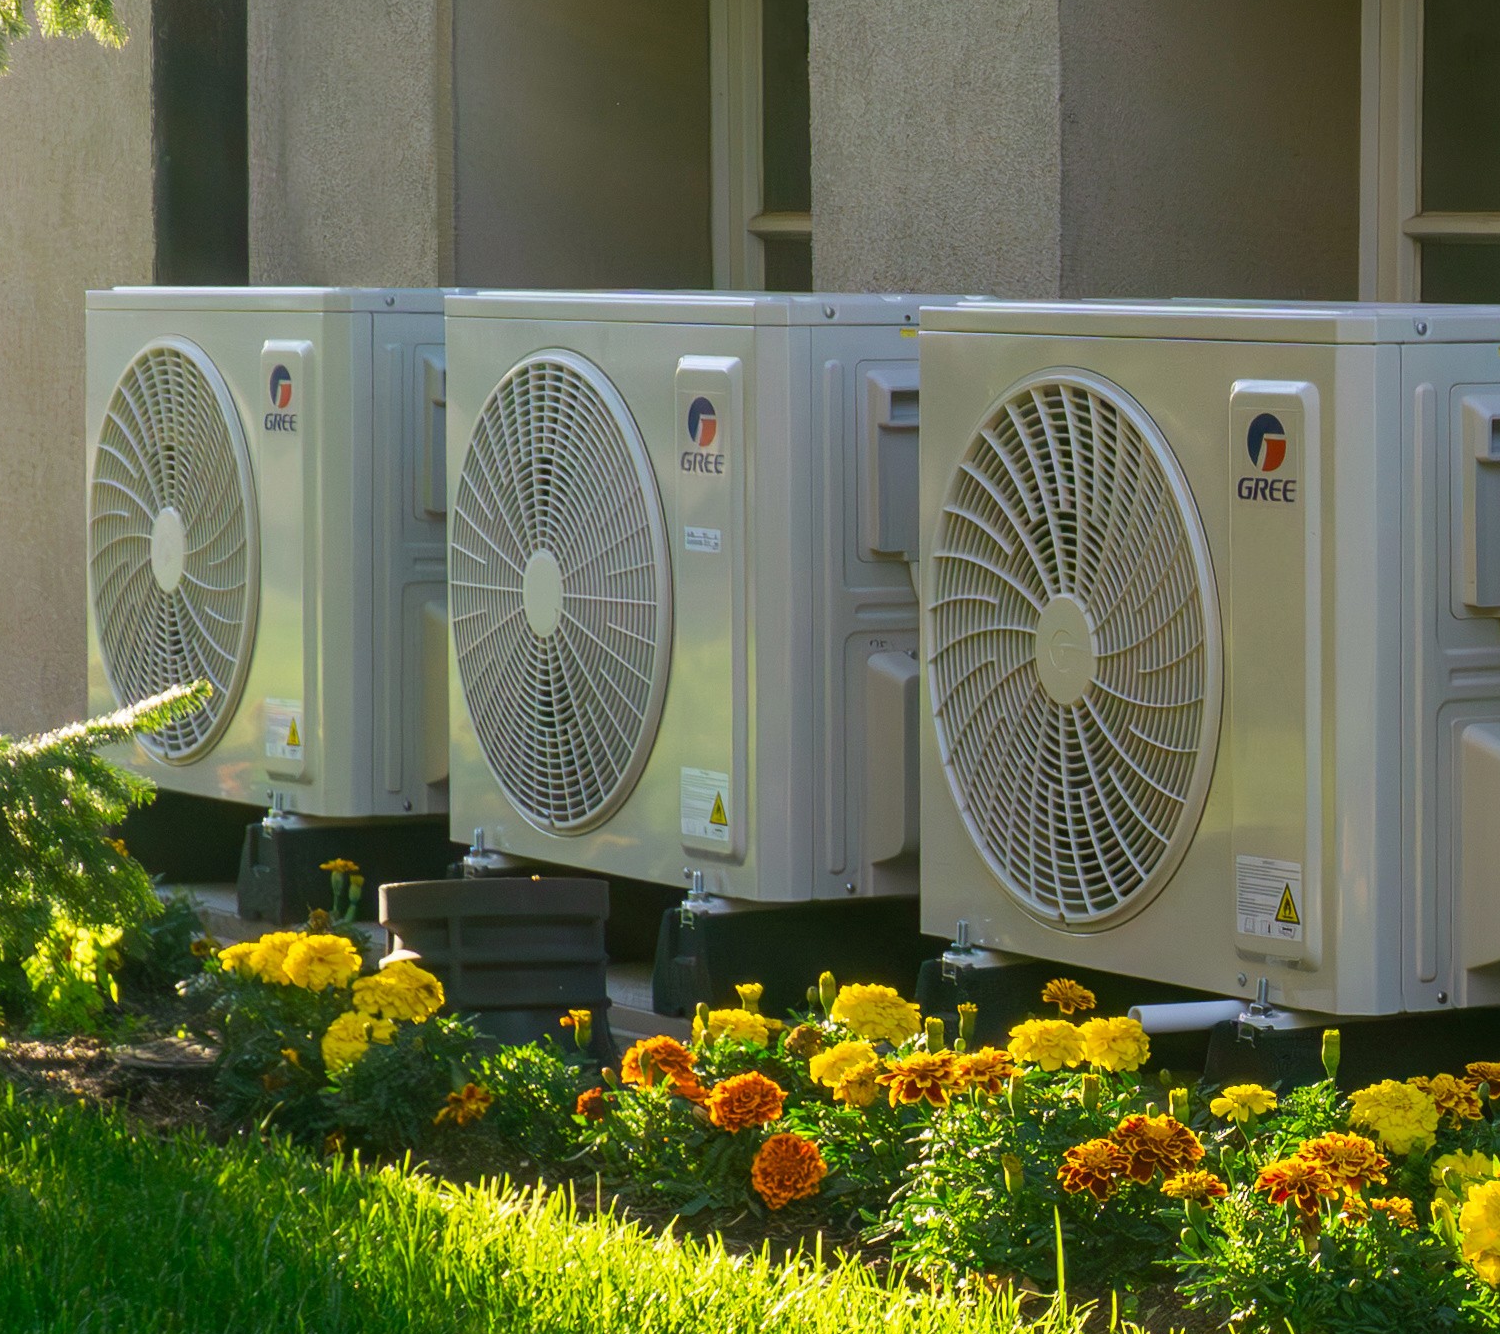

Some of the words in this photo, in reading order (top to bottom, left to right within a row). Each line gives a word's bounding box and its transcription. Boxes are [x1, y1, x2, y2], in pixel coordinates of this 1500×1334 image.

[264, 413, 297, 432] GREE
[681, 451, 725, 474] GREE
[1237, 477, 1297, 502] GREE
